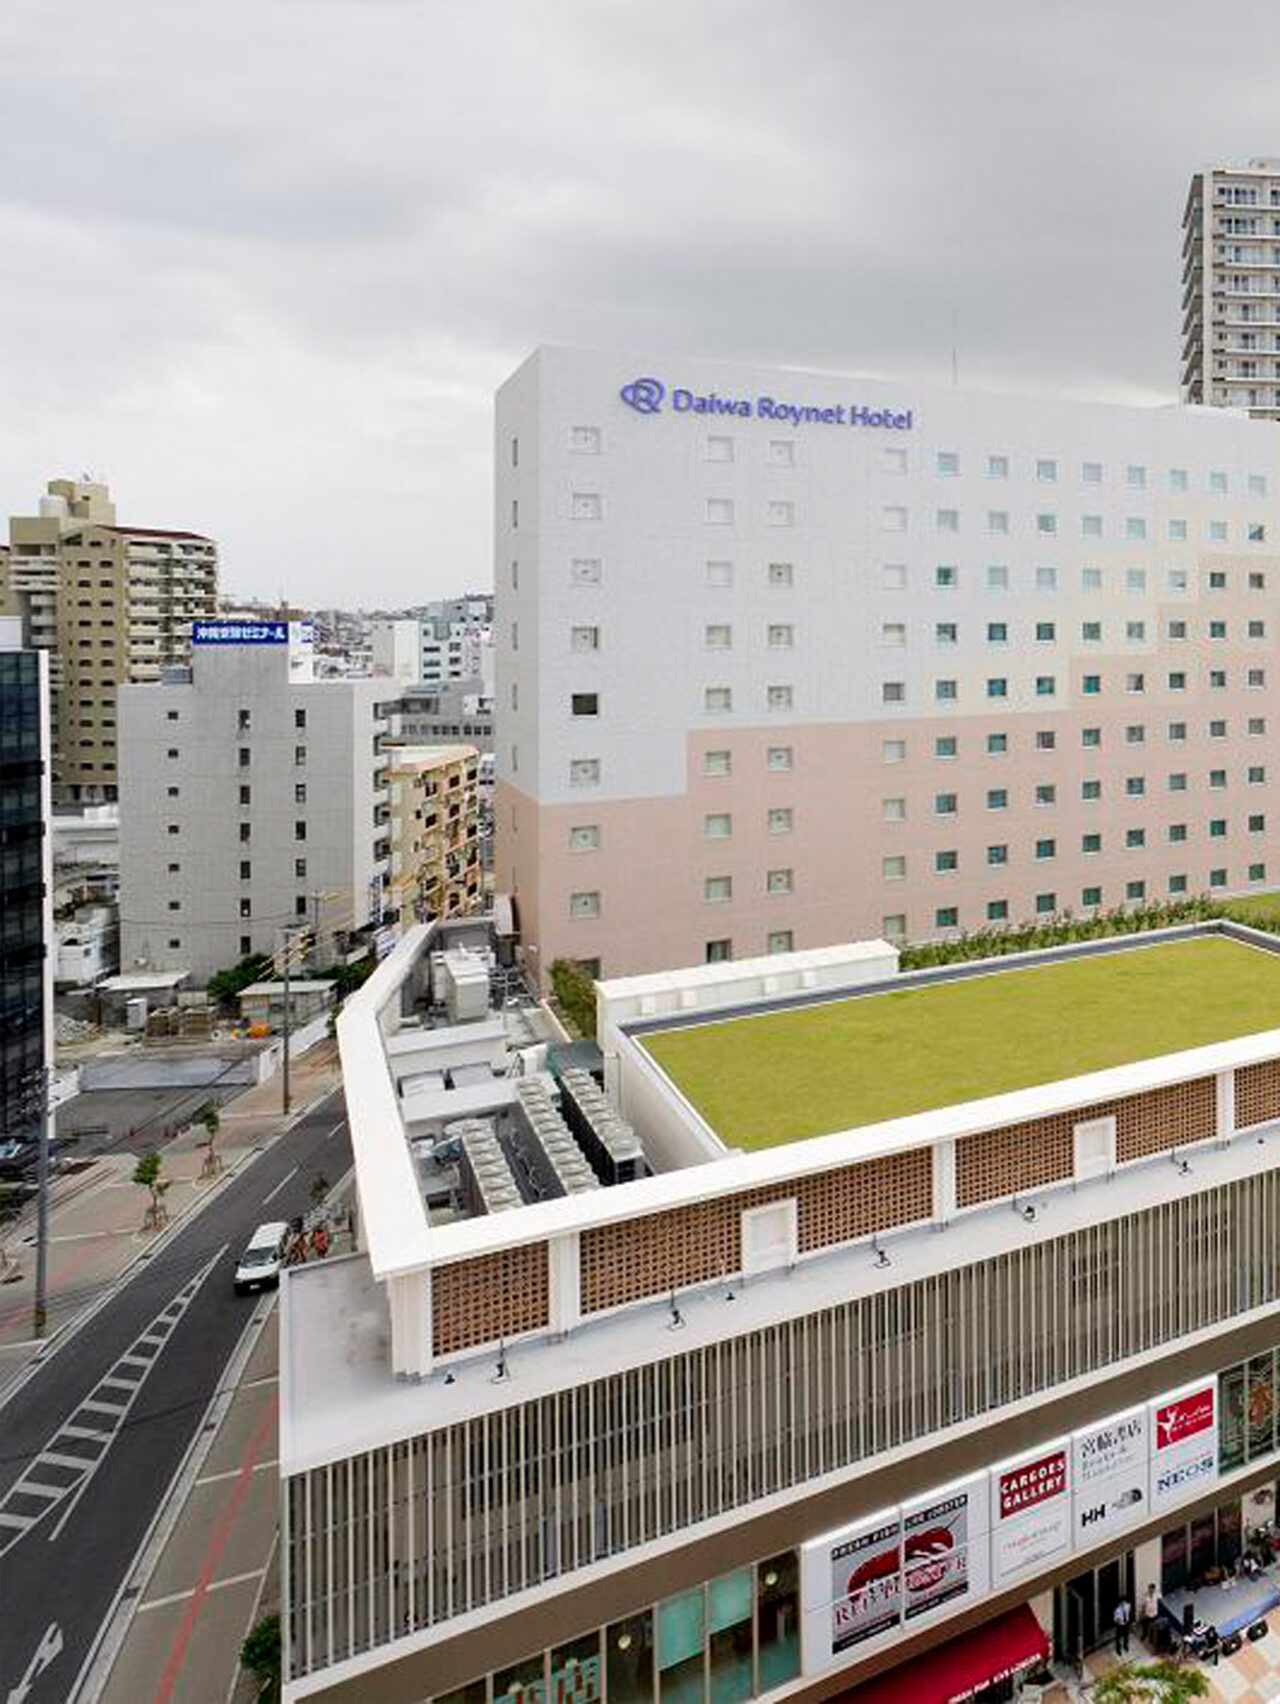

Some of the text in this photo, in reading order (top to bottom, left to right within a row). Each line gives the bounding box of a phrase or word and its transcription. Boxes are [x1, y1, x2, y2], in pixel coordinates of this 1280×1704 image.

[672, 389, 912, 430] Daiwa Roynet Hotel
[1001, 1461, 1065, 1494] CARGOES
[1157, 1456, 1214, 1492] NEOS
[1002, 1475, 1062, 1509] GALLERY
[1081, 1504, 1106, 1527] HH
